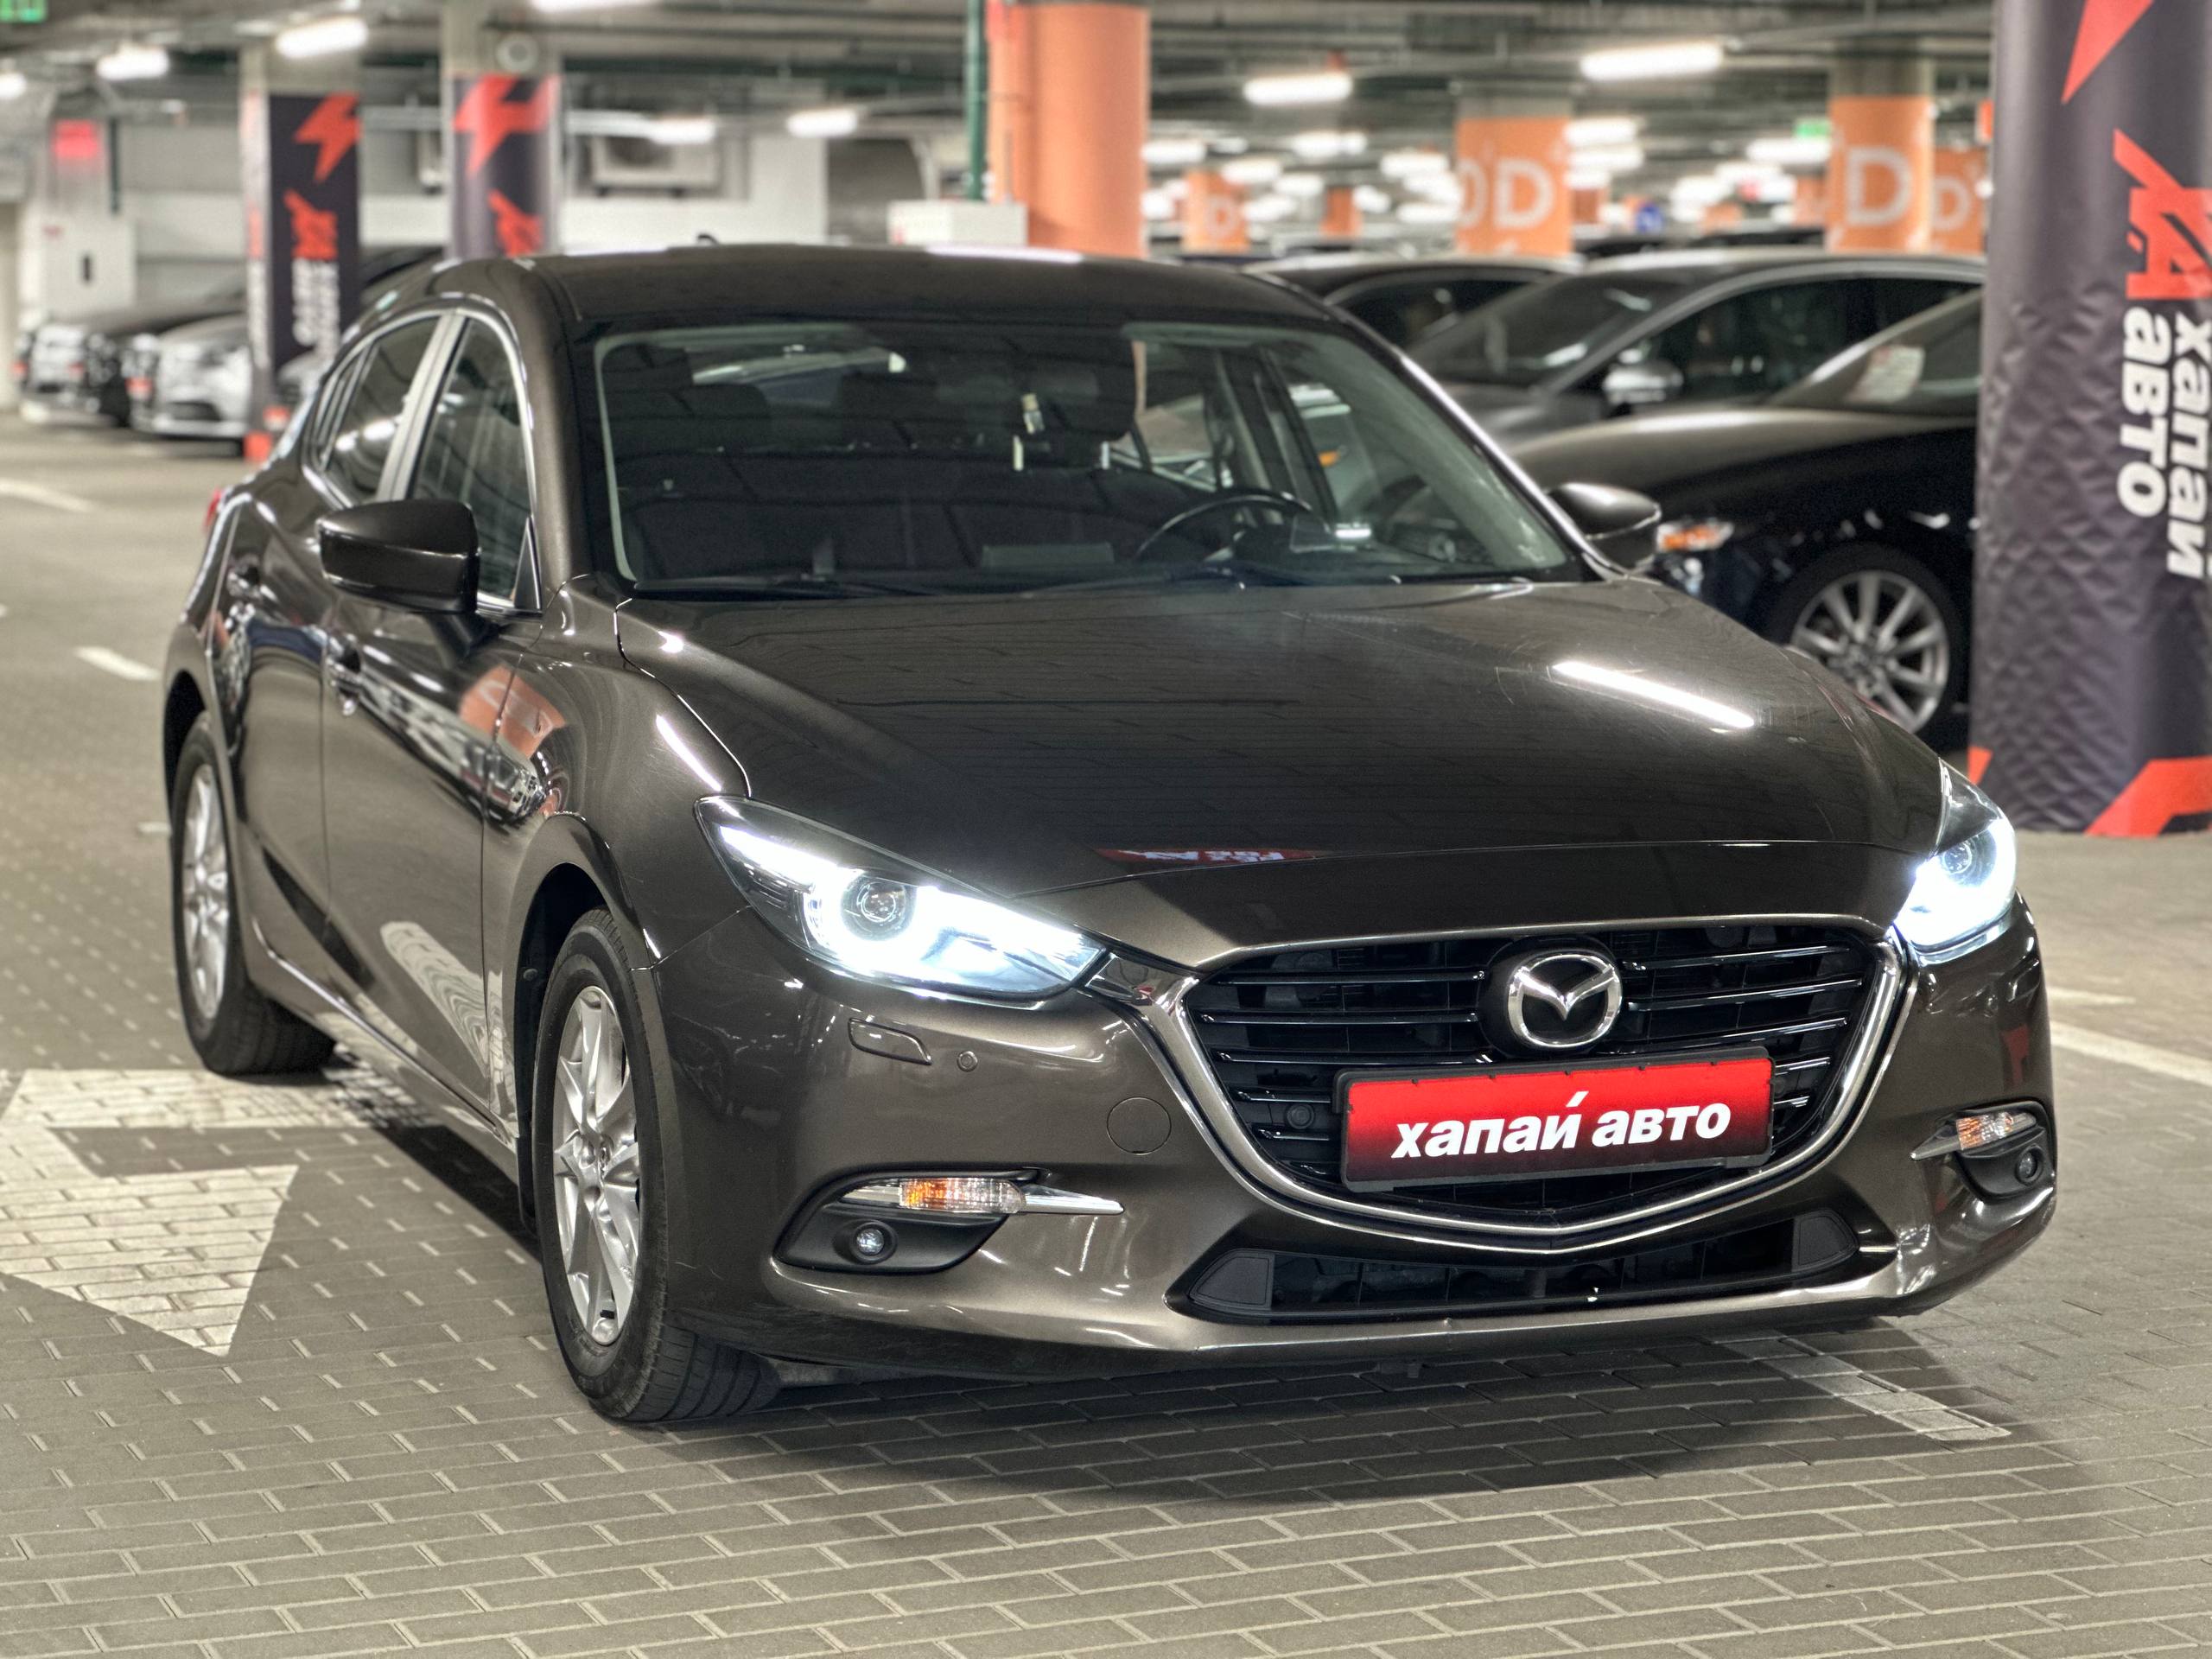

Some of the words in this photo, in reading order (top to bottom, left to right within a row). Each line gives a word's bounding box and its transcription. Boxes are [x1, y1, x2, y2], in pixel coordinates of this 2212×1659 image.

[1495, 157, 1554, 231] D
[1846, 147, 1911, 226] D
[2117, 307, 2171, 518] авто
[1391, 1090, 1588, 1159] хапай
[1592, 1103, 1731, 1147] авто
